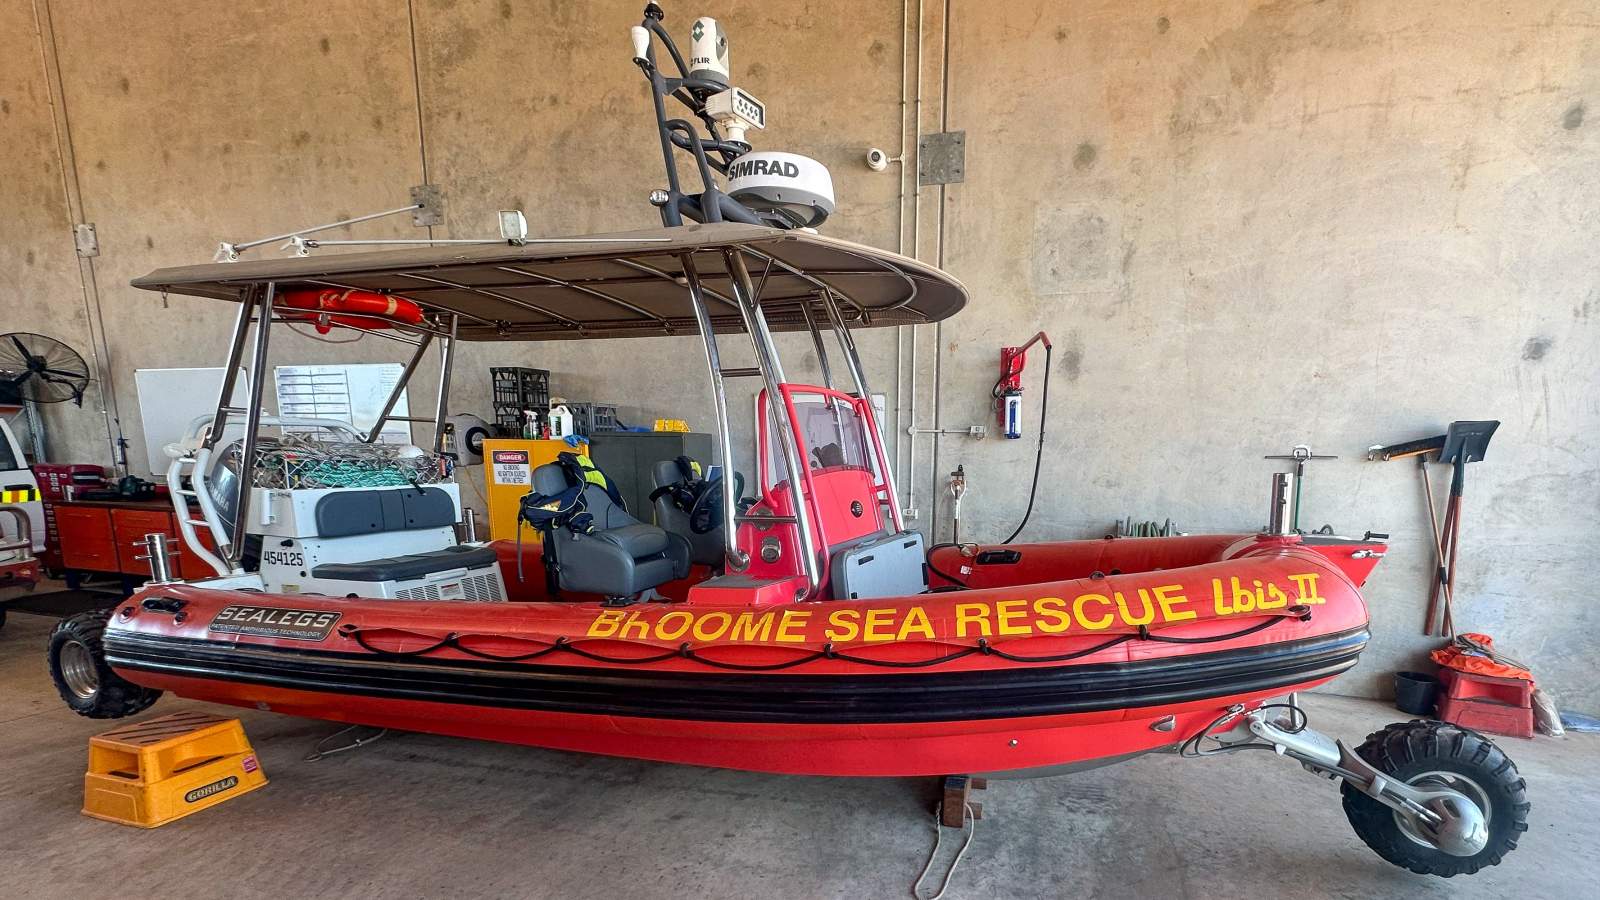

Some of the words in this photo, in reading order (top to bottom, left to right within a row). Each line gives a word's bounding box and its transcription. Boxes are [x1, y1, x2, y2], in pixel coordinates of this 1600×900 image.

[728, 159, 799, 181] SIMRAD
[263, 551, 303, 567] 454125
[217, 607, 335, 628] SEALEGS
[825, 606, 936, 642] SEA
[955, 584, 1197, 637] RESCUE
[240, 625, 279, 634] AMPHIBIOUS
[280, 629, 321, 638] TECHNOLOGY
[188, 778, 235, 801] GORILLA
